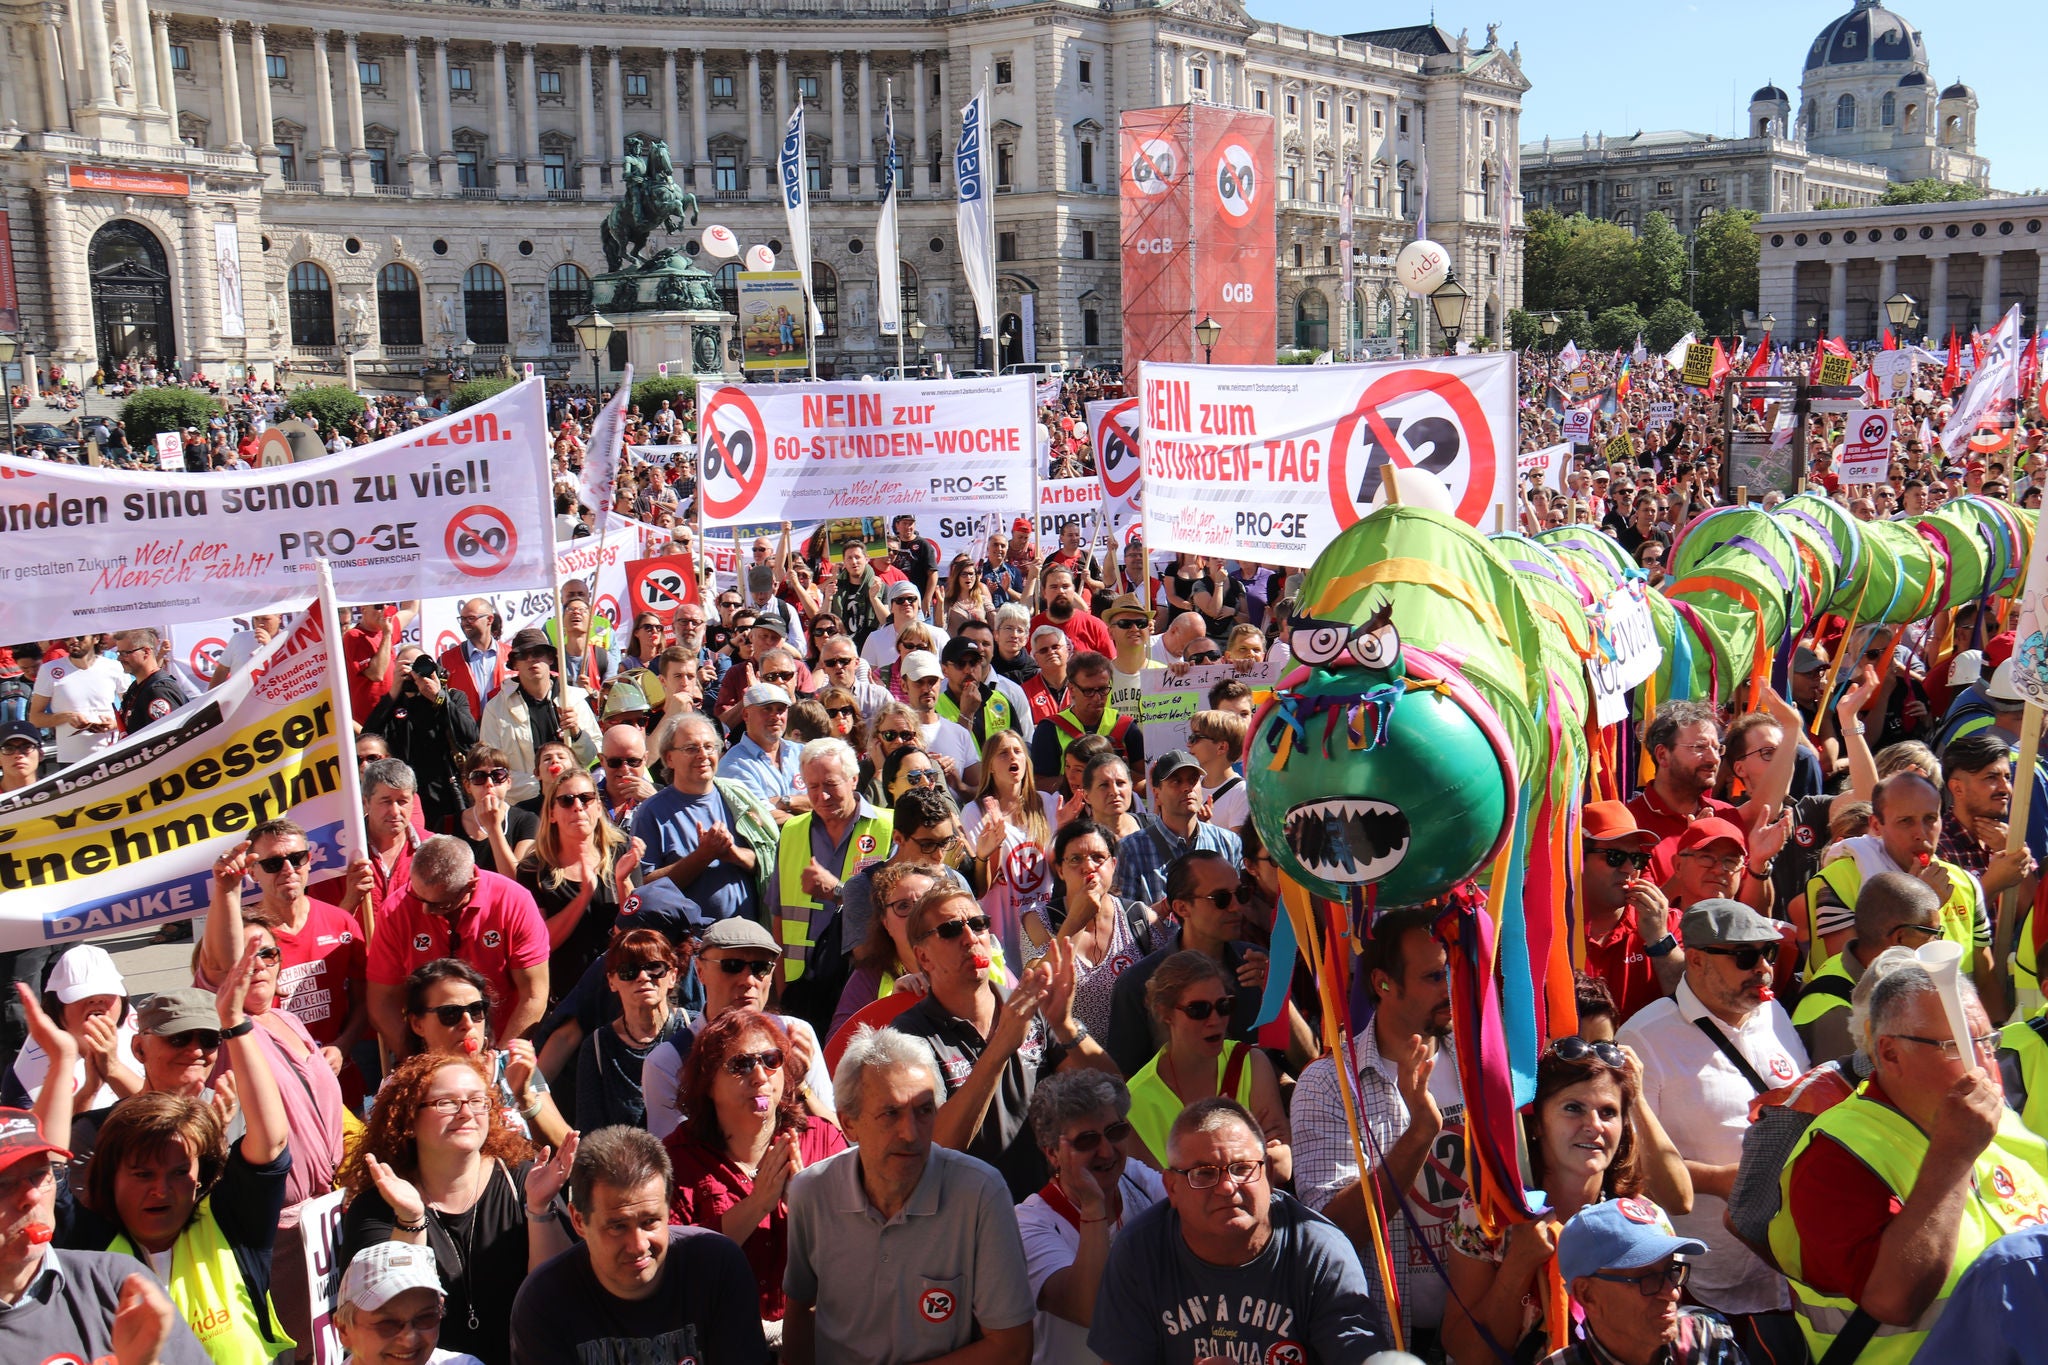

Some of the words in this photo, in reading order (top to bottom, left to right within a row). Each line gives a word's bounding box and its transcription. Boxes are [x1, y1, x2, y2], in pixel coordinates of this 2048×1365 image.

[1218, 162, 1255, 200] 60
[1410, 251, 1442, 281] vida
[1687, 353, 1713, 365] NAZIS
[1688, 345, 1714, 356] LASST
[1685, 361, 1712, 373] NICHT
[1824, 364, 1848, 375] NAZIS
[1825, 356, 1850, 368] LASST
[1822, 370, 1847, 382] NICHT
[802, 393, 883, 428] NEIN
[892, 404, 936, 426] zur
[1146, 379, 1192, 433] NEIN
[1199, 403, 1257, 436] zum
[1863, 425, 1884, 439] 60
[773, 427, 1021, 461] 60-STUNDEN-WOCHE
[1606, 434, 1627, 453] LASST
[703, 430, 753, 481] 60
[353, 473, 398, 504] zu
[409, 459, 492, 499] viel!
[850, 478, 877, 494] Weil
[878, 480, 903, 495] der
[828, 489, 883, 510] Mensch
[1040, 483, 1102, 505] Arbeit
[456, 526, 507, 557] 60
[133, 538, 184, 568] Weil
[188, 540, 229, 564] der
[14, 559, 75, 582] gestalten
[77, 555, 129, 573] Zukunft
[90, 558, 197, 596] Mensch
[202, 552, 275, 583] zählt!
[283, 564, 299, 574] DIE
[646, 575, 682, 603] 12
[72, 597, 201, 617] www.neinzum12stundentag.at
[266, 664, 327, 700] 60-Stunden-
[1162, 669, 1192, 688] Was
[1197, 671, 1209, 684] ist
[283, 679, 319, 703] Woche
[55, 736, 179, 797] bedeutet
[51, 883, 196, 934] DANKE
[414, 935, 432, 949] 12
[485, 932, 501, 947] 12
[293, 963, 309, 979] BIN
[309, 960, 326, 976] EIN
[304, 989, 331, 1007] KEINE
[298, 1005, 330, 1023] SCHINE
[926, 1297, 950, 1314] 12
[1238, 1295, 1295, 1339] CRUZ
